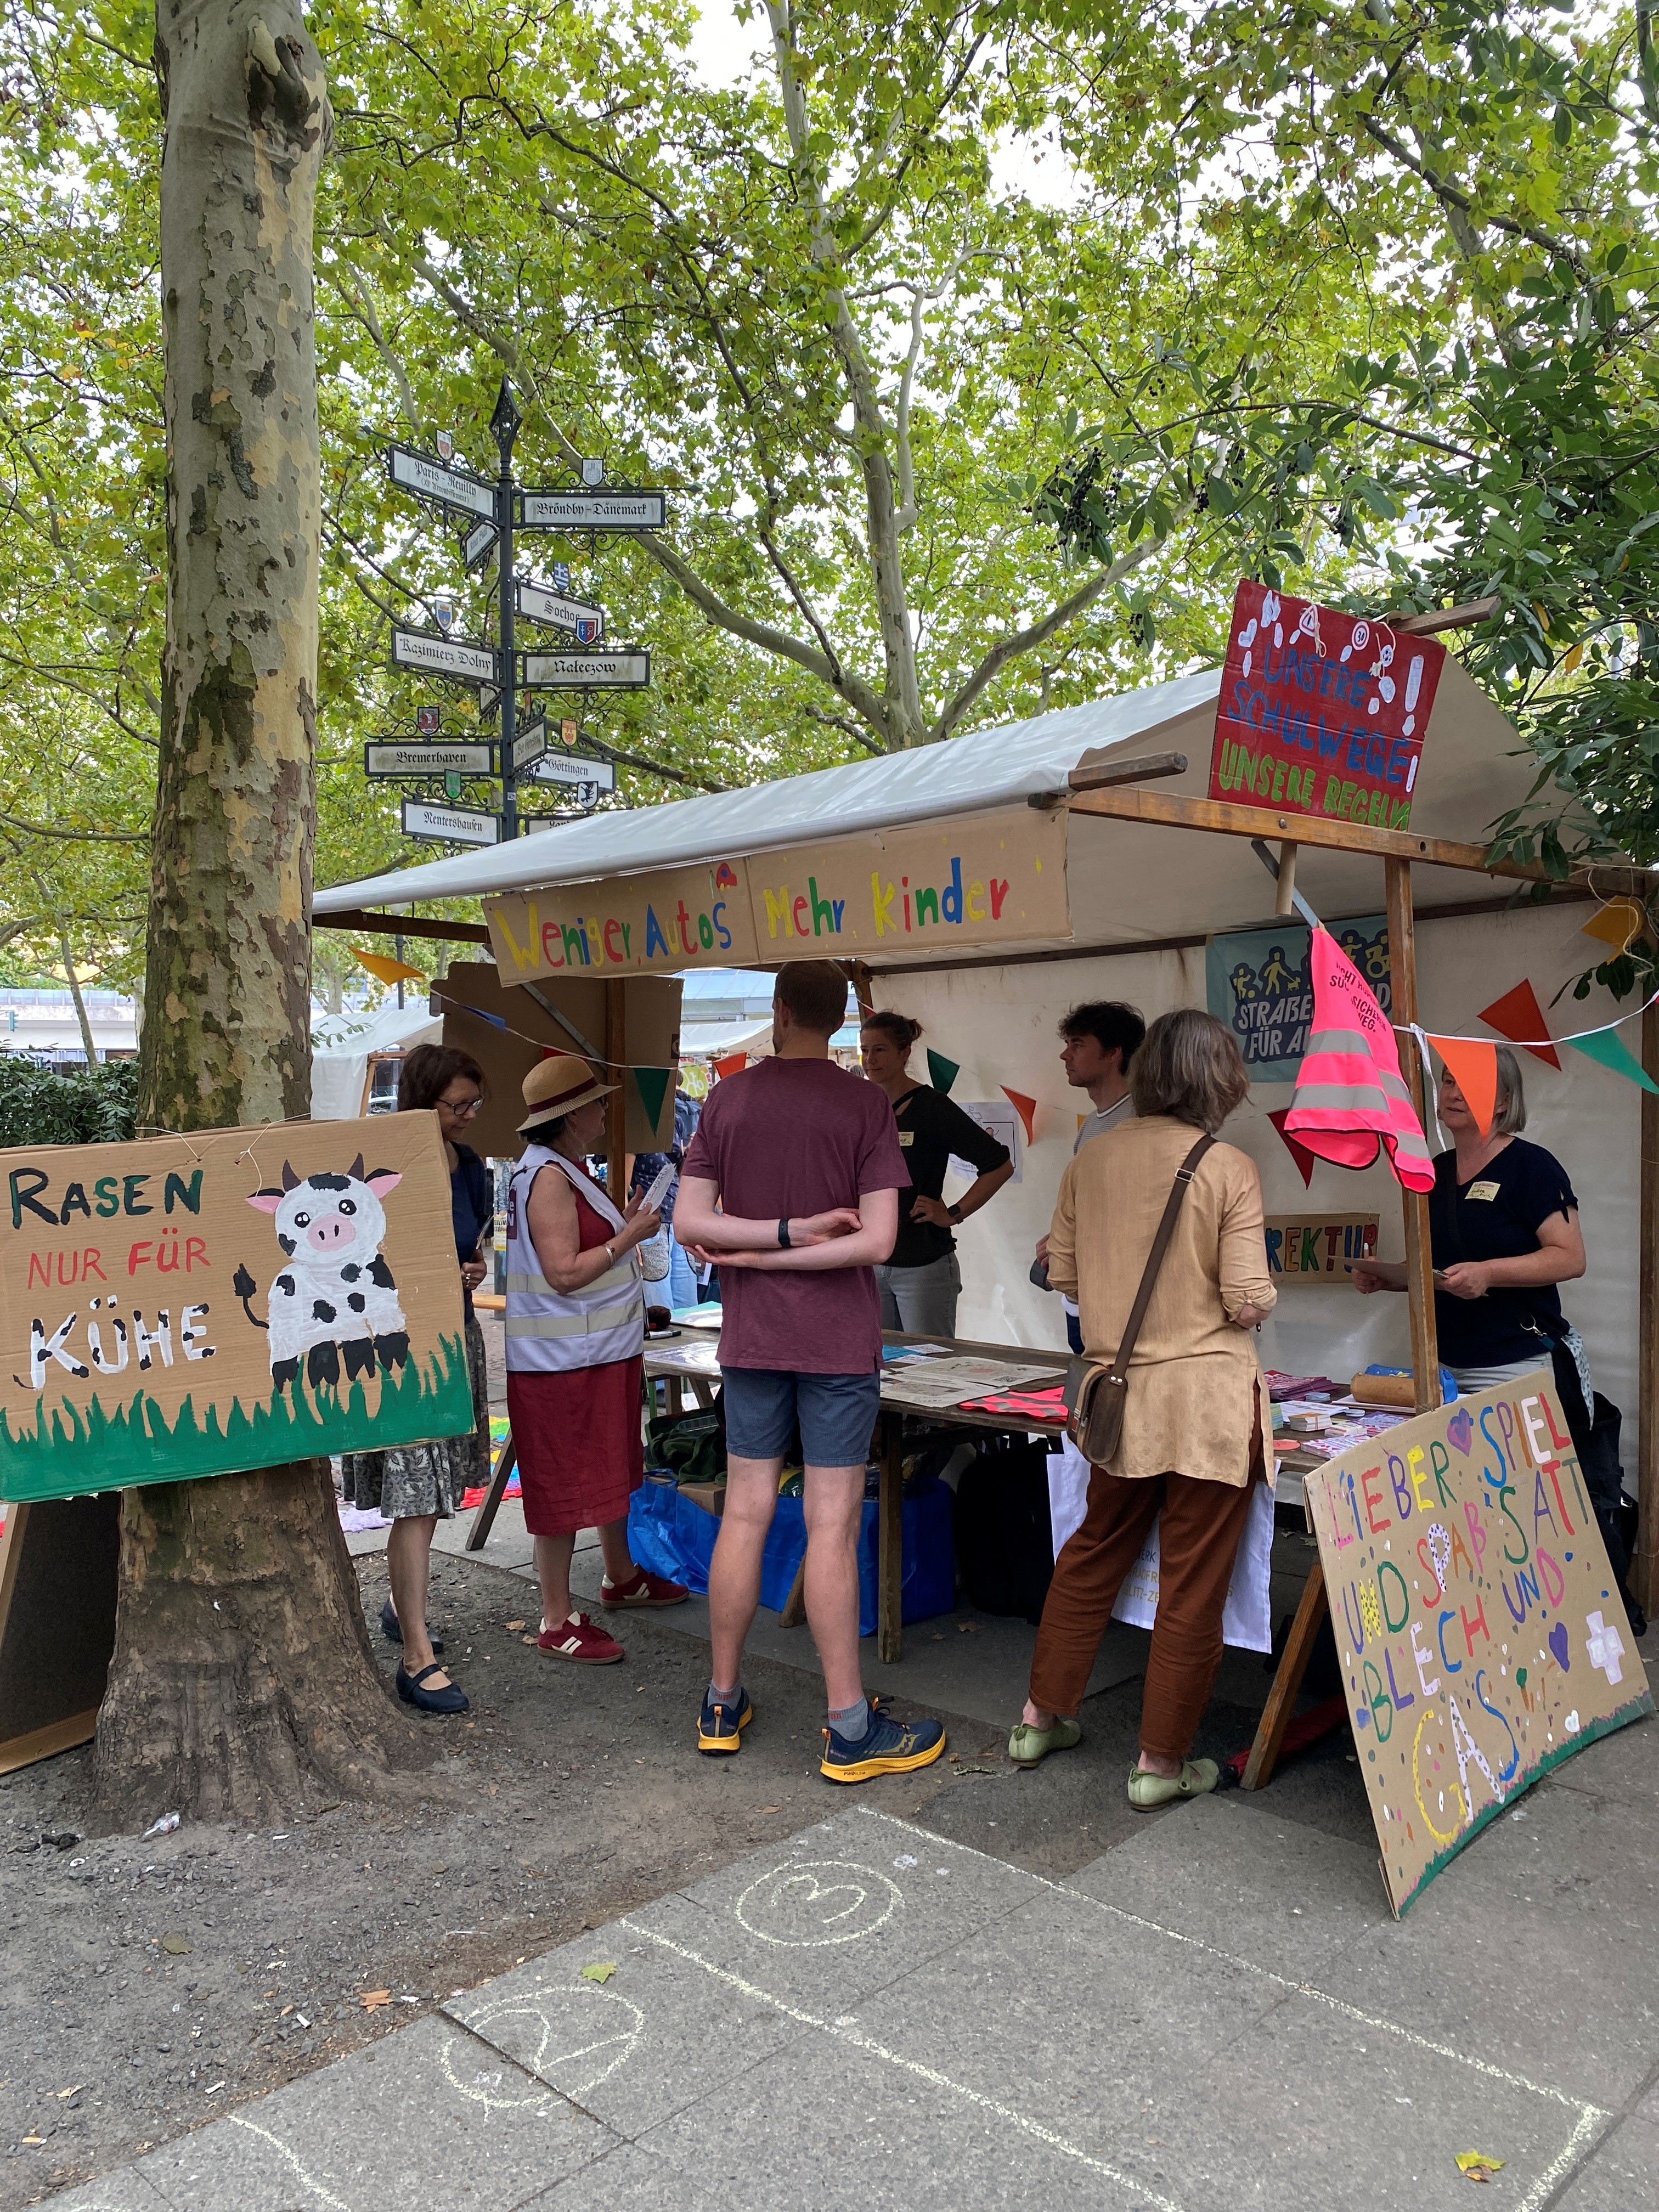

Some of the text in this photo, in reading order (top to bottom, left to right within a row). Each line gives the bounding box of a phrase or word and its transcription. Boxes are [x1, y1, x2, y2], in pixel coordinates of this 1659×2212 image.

[415, 461, 439, 481] Paris
[448, 475, 477, 497] Reuilly
[399, 637, 492, 672] Kazimierz Dolny
[1357, 629, 1365, 642] 30
[1264, 642, 1372, 709] UNSERE
[396, 751, 466, 764] Bremerhaven
[549, 758, 589, 776] Göttingen
[1218, 738, 1412, 832] UNSERE REGELN
[762, 876, 845, 939] Mehr
[1238, 994, 1314, 1030] STRAßE
[1248, 1026, 1283, 1059] FÜR
[9, 1167, 204, 1229] RASEN
[28, 1228, 211, 1289] NUR FÜR
[13, 1294, 217, 1390] KÜHE
[1480, 1392, 1573, 1488] SPIEL
[1342, 1561, 1409, 1655] UND
[1362, 1546, 1565, 1743] BLECH UND
[1413, 1669, 1520, 1846] GAS
[770, 1874, 868, 1925] 3
